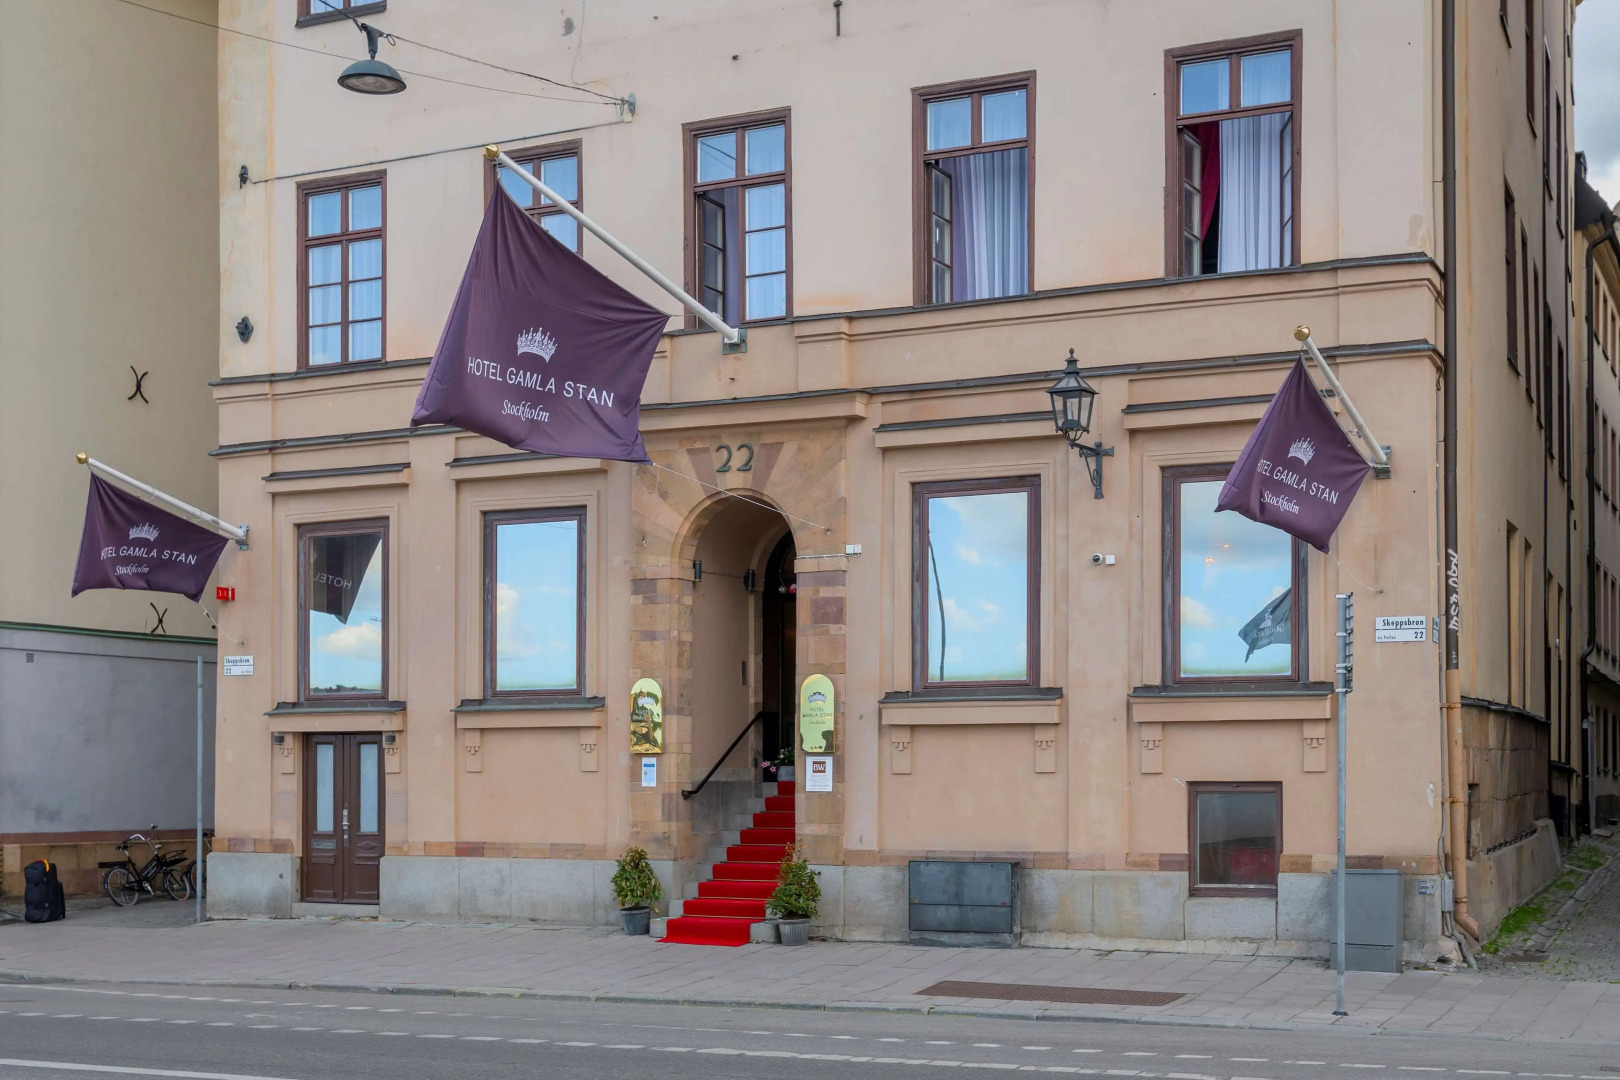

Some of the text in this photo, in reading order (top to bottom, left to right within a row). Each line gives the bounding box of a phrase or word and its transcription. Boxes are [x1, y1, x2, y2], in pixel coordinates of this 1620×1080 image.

[467, 357, 615, 408] HOTEL GAMLA STAN
[501, 399, 550, 423] Stockholm
[715, 443, 754, 473] 22
[1273, 466, 1307, 492] GAMLA
[1309, 482, 1339, 505] STAN
[1260, 490, 1300, 515] Stockholm
[119, 546, 157, 558] GAMLA
[161, 550, 197, 565] STAN
[114, 563, 150, 576] Stockholm
[1382, 617, 1424, 629] Skeppsbron
[1413, 631, 1424, 639] 22
[225, 656, 250, 666] Skeppsbron
